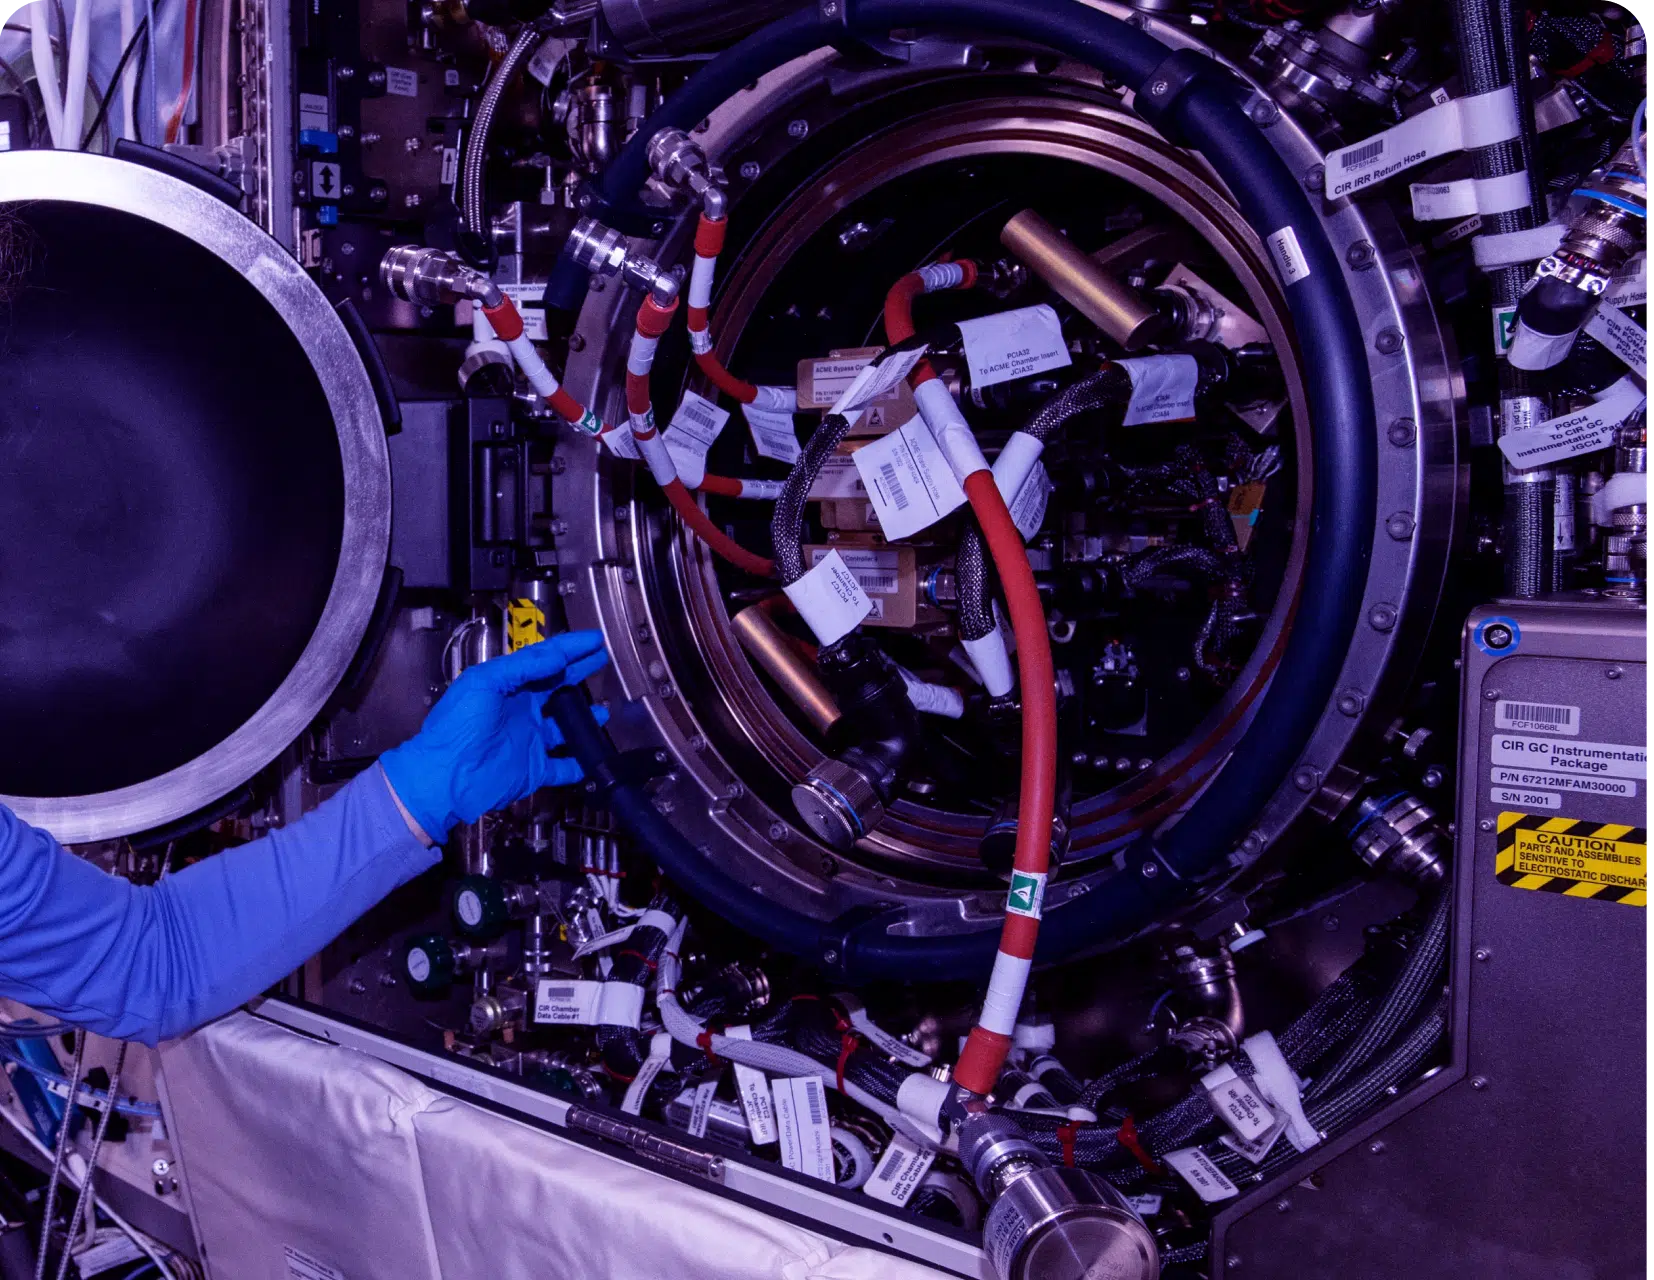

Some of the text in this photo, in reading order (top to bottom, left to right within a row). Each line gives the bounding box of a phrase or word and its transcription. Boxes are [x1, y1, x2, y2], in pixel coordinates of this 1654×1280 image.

[1334, 150, 1427, 195] CIR IRR Return Hose
[1277, 238, 1291, 268] Handle
[1605, 292, 1648, 306] Supply Hose
[815, 365, 832, 373] ACME
[833, 365, 854, 374] Bypass
[979, 350, 1059, 376] To ACME Chamber Insert
[1549, 419, 1604, 442] To CIR GC
[1517, 431, 1599, 458] Instrumentation
[828, 565, 860, 606] To Chamber
[1511, 721, 1560, 732] FCF10668L
[1501, 740, 1524, 751] CIR
[1529, 742, 1549, 753] GC
[1550, 756, 1608, 773] Package
[1500, 772, 1626, 793] P/N 67212MFAM30000
[1501, 792, 1549, 805] S/N 2001
[1520, 842, 1641, 866] PARTS AND ASSEMBLIES
[1537, 833, 1616, 853] CAUTION
[1520, 852, 1585, 868] SENSITIVE TO
[1519, 862, 1648, 888] ELECTROSTATIC DISCHAR
[1234, 1096, 1255, 1120] Chamber
[1250, 1116, 1261, 1126] To
[889, 1181, 903, 1197] CIR
[898, 1147, 924, 1182] Chamber
[896, 1181, 911, 1201] Data
[907, 1159, 925, 1183] Cable
